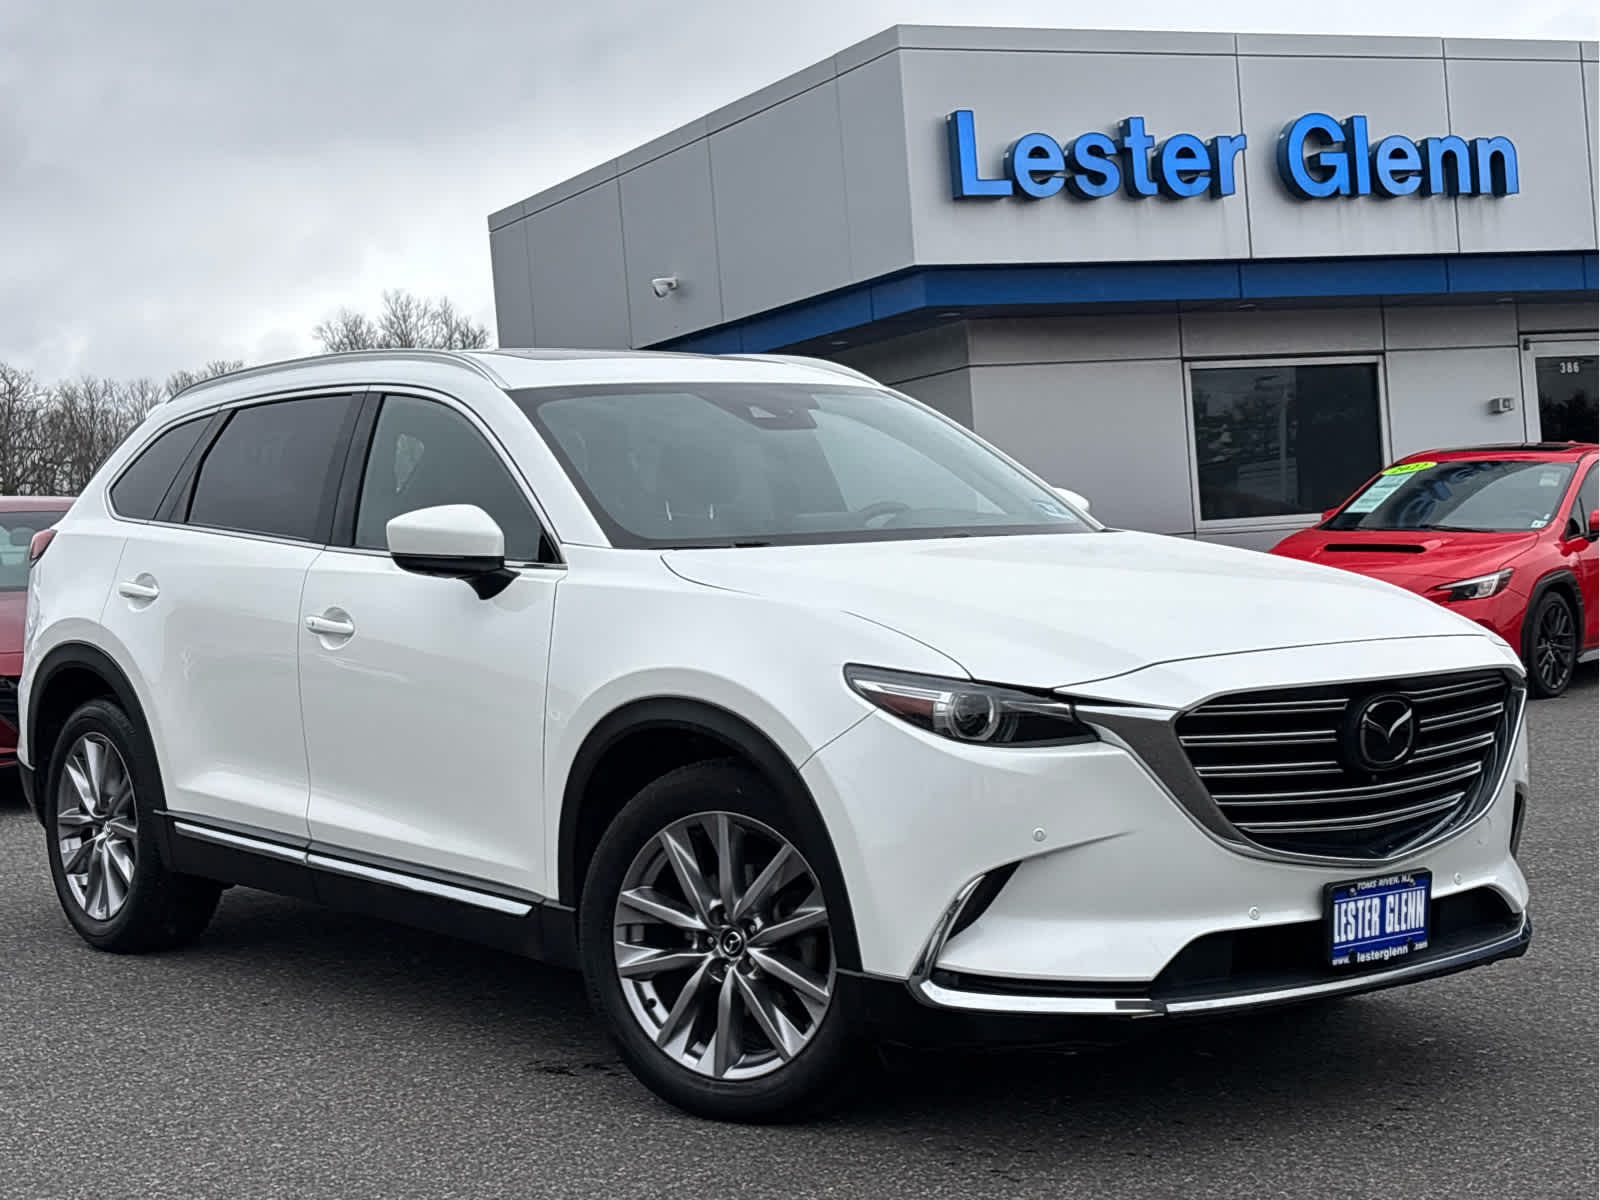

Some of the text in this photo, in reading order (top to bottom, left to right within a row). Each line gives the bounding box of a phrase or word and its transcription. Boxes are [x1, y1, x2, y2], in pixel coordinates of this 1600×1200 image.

[948, 110, 1520, 200] Lester Glenn
[1560, 361, 1579, 374] 386
[1333, 890, 1425, 943] LESTER GLENN
[1357, 944, 1409, 963] lesterglenn
